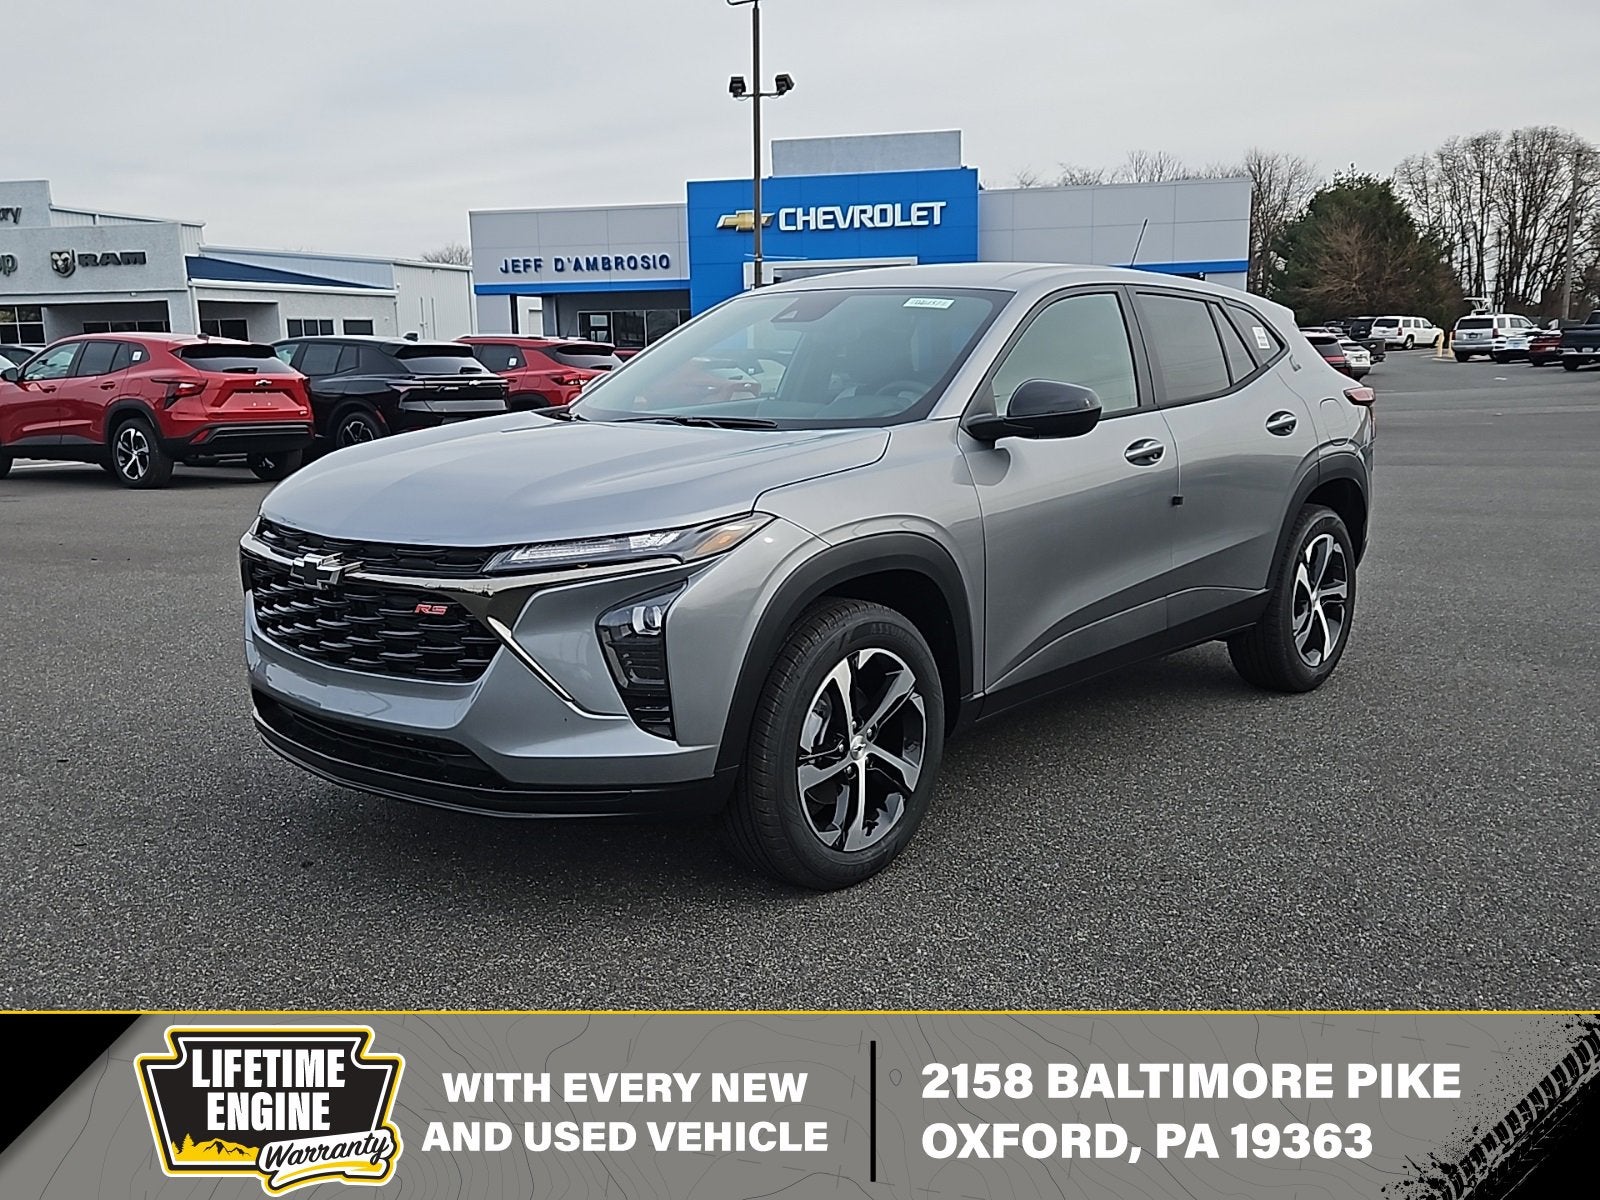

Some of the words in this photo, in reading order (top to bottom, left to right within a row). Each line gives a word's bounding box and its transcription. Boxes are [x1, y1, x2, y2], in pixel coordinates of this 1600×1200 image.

[777, 201, 947, 233] CHEVROLET
[77, 251, 147, 267] RAM
[500, 258, 542, 274] JEFF
[554, 254, 670, 272] D'AMBROSIO
[415, 604, 448, 615] RS
